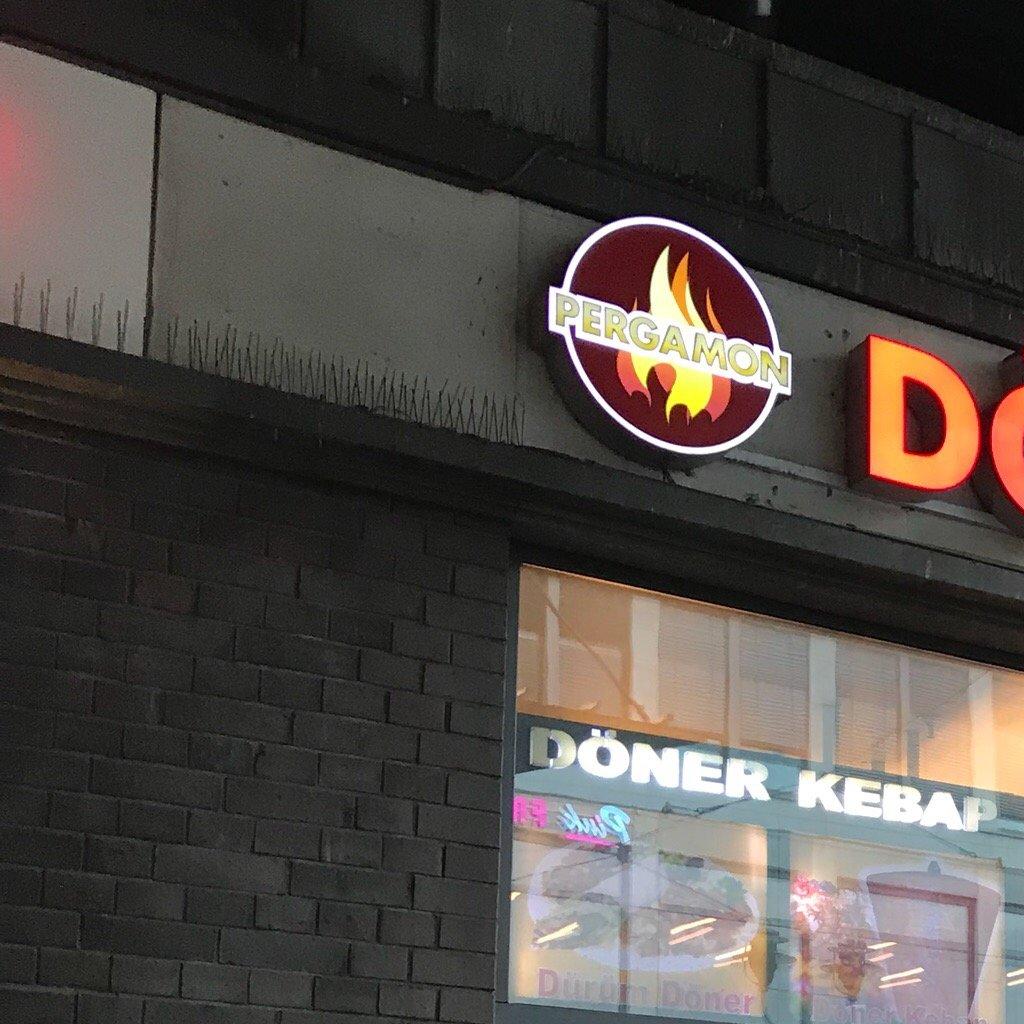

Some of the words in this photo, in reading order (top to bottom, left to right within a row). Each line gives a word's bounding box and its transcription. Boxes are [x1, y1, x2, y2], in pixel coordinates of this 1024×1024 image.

[555, 291, 790, 388] PERGAMON
[529, 727, 771, 801] DÖNER
[797, 770, 998, 832] KEBAP
[659, 980, 755, 1016] Döner
